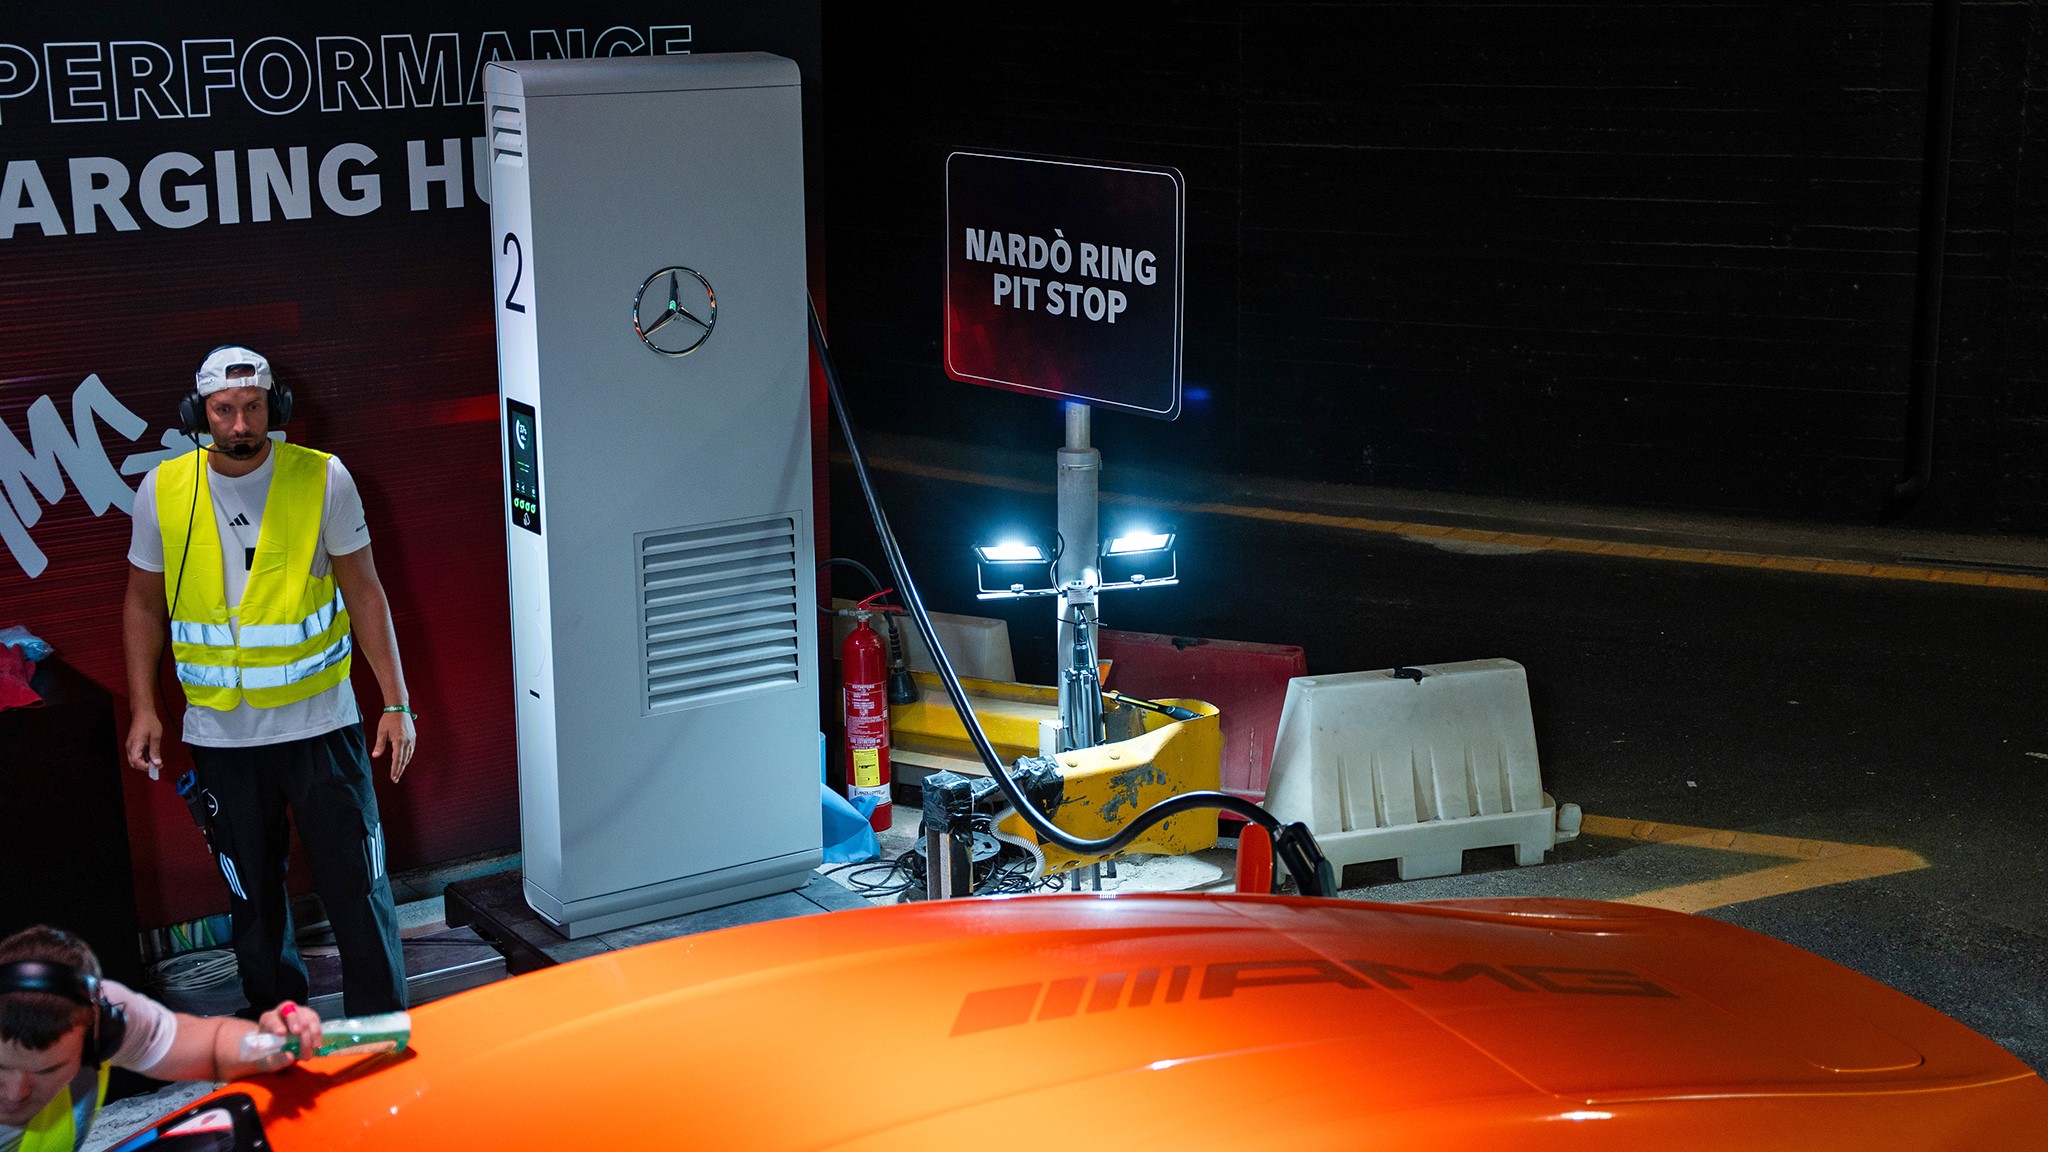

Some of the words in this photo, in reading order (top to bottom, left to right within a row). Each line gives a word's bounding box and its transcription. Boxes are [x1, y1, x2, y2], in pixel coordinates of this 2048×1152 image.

[0, 142, 382, 238] ARGING
[503, 232, 526, 314] 2
[966, 228, 1073, 273] NARDÒ
[1080, 242, 1157, 286] RING
[993, 272, 1040, 311] PIT
[1046, 281, 1127, 324] STOP
[1199, 959, 1682, 1000] AMG
